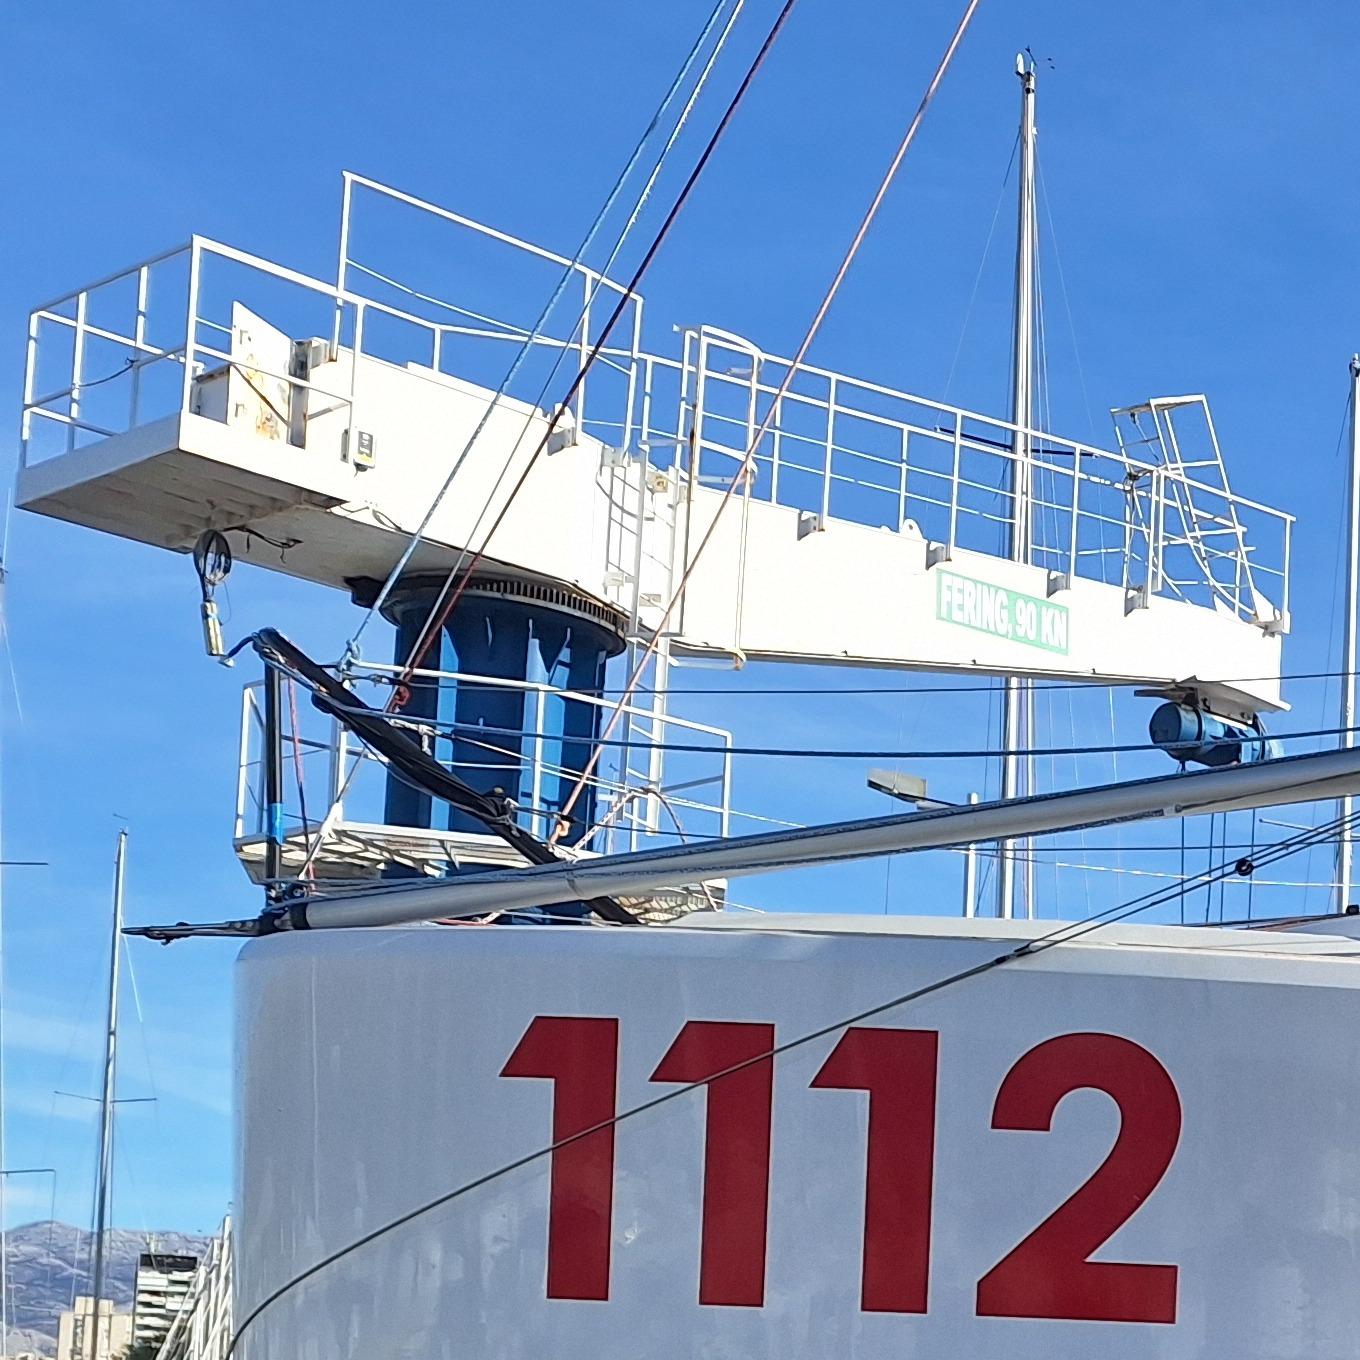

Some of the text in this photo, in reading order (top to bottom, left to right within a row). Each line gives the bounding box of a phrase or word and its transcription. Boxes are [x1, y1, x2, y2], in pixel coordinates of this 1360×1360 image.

[940, 572, 1067, 649] FERING, 90 KN
[500, 1015, 1182, 1325] 1112
